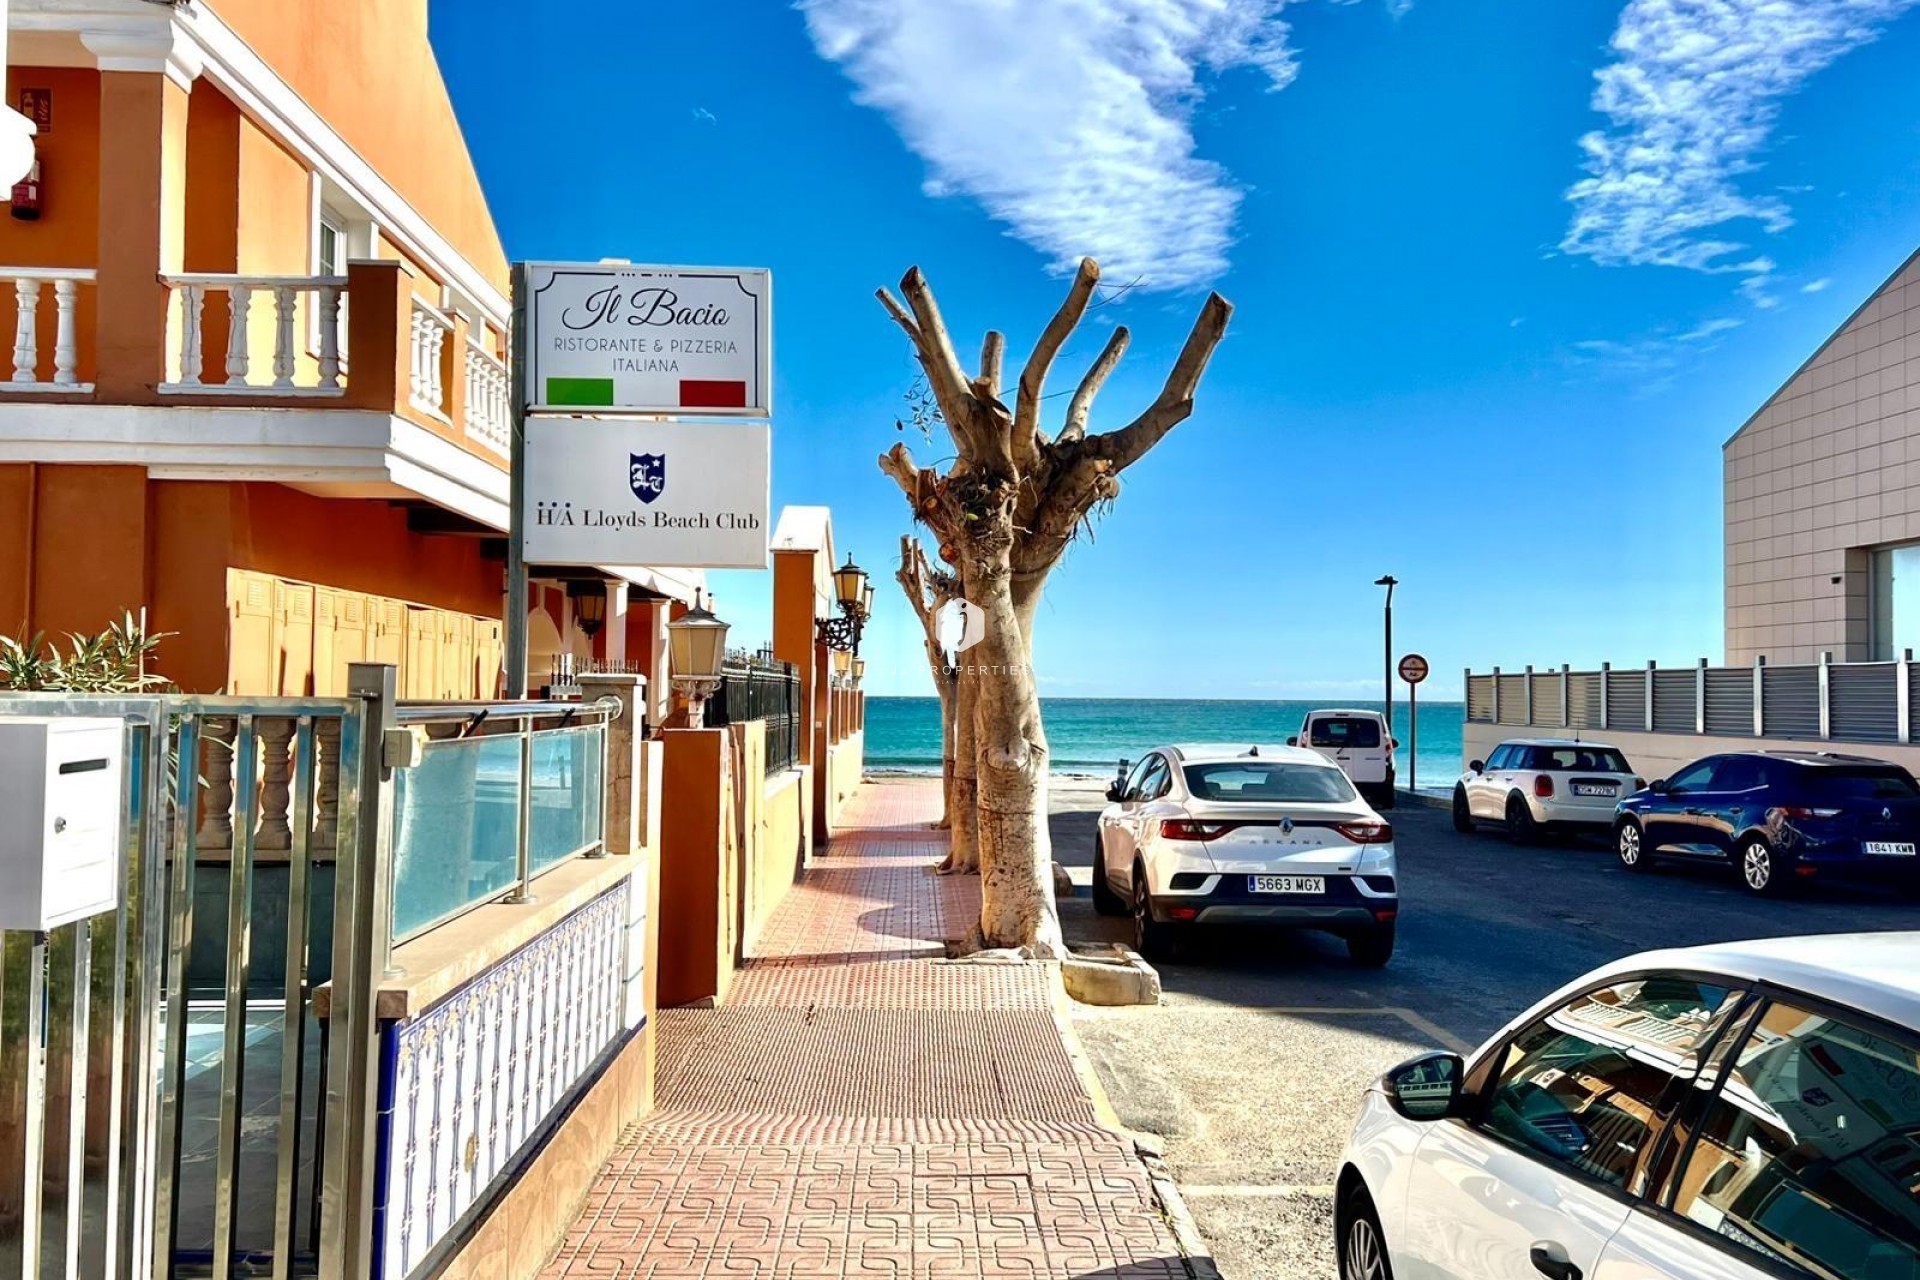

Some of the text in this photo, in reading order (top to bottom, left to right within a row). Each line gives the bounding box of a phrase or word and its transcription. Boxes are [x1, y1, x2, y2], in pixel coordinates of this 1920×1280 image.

[562, 285, 730, 330] Il Bacio
[554, 337, 738, 354] RISTORANTE & PIZZERIA
[612, 358, 679, 372] ITALIANA
[583, 509, 646, 531] Lloyds
[653, 511, 710, 529] Beach
[715, 513, 759, 530] Club
[1258, 878, 1321, 892] 5663 MGX
